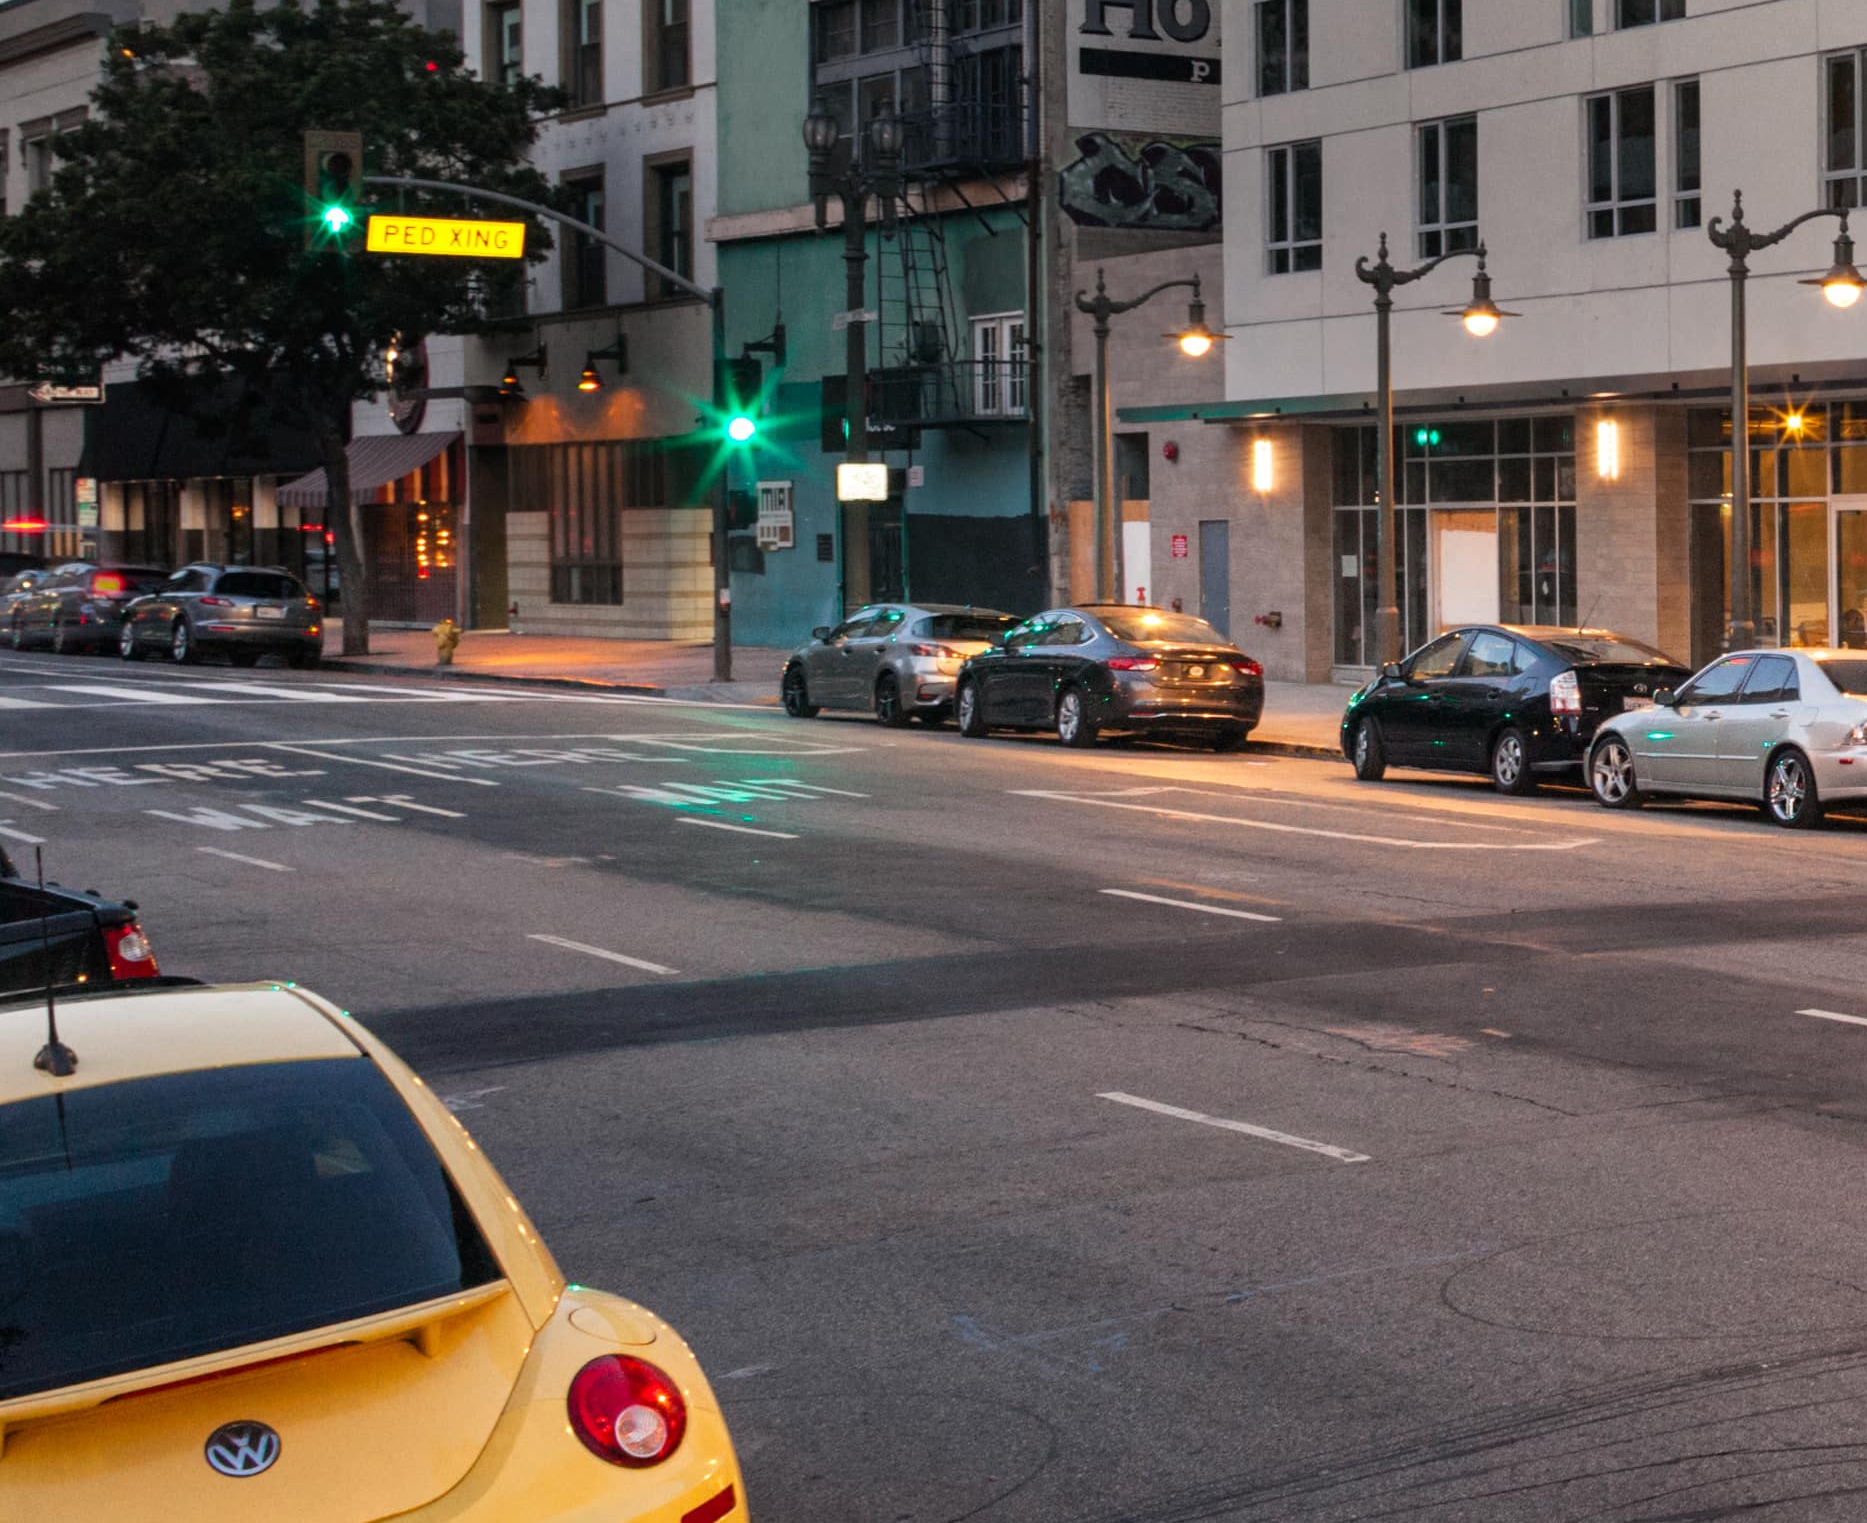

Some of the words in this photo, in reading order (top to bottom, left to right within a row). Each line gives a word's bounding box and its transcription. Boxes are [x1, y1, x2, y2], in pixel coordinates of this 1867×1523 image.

[384, 224, 436, 246] PED
[450, 228, 509, 249] XING
[143, 794, 468, 831] WAIT
